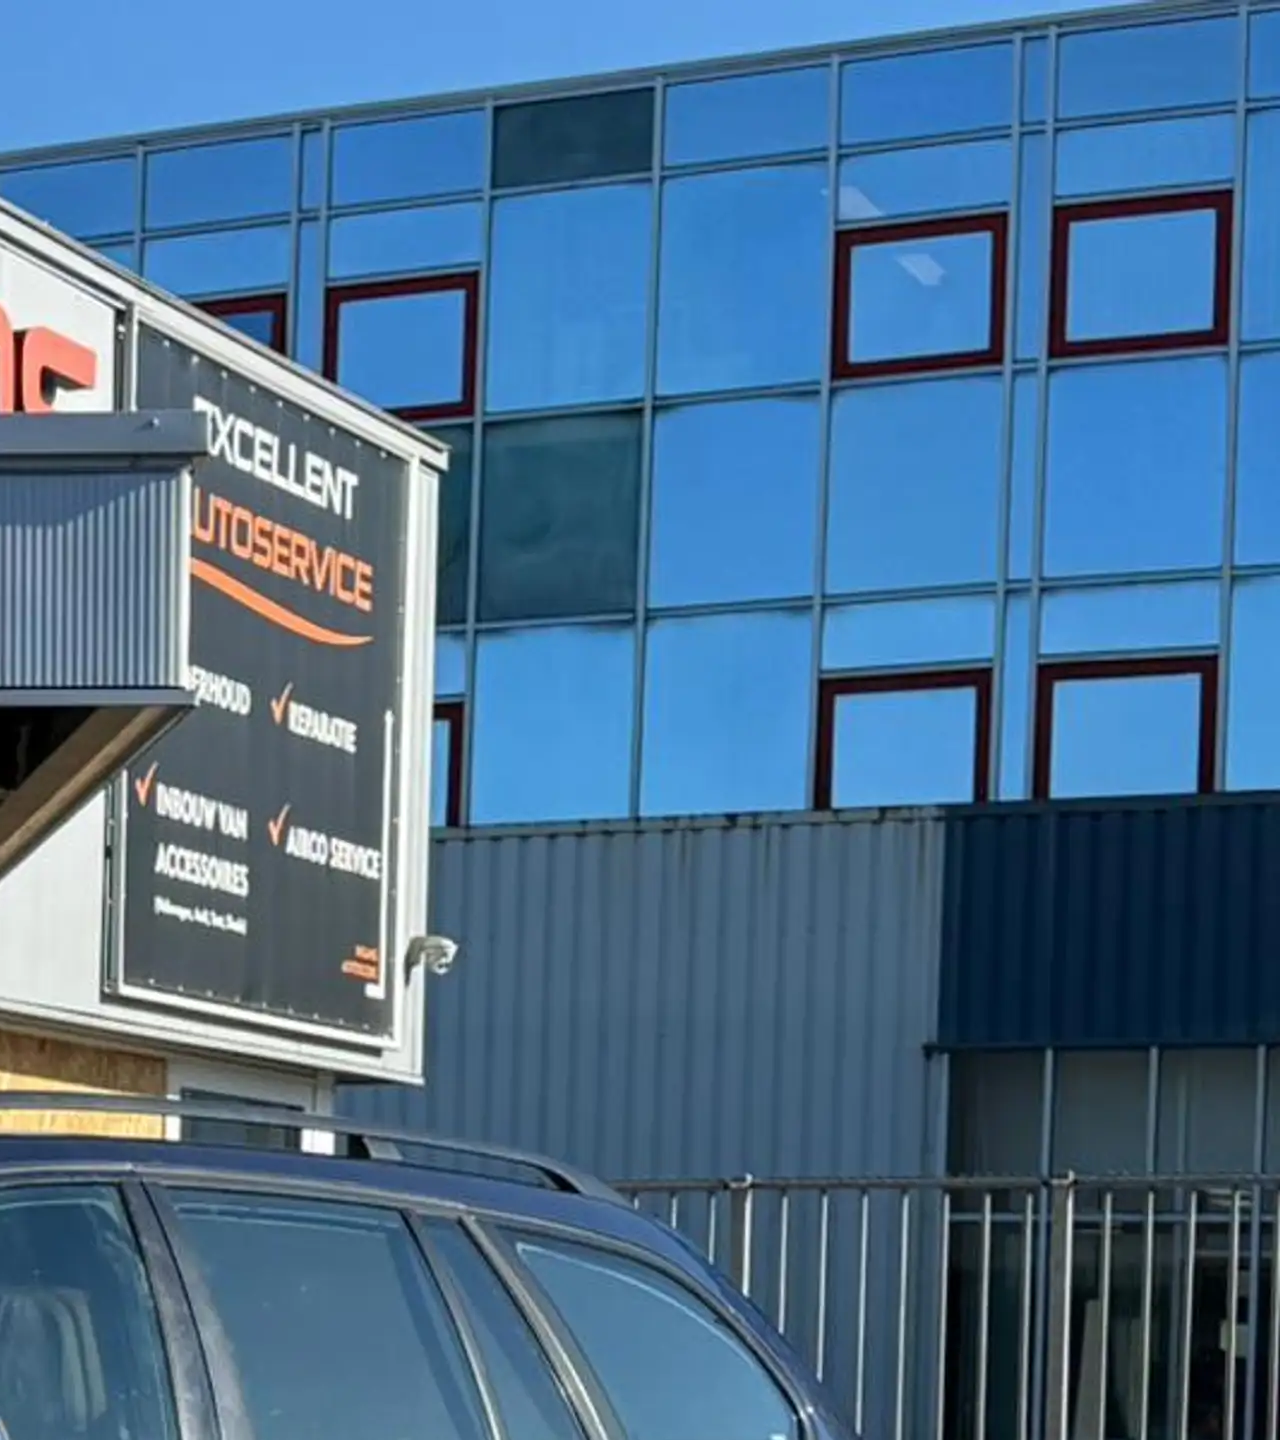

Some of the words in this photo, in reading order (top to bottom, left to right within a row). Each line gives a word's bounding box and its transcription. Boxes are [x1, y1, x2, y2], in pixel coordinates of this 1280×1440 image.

[192, 486, 374, 612] UTOSERVICE
[154, 842, 249, 898] ACCESSOIRES
[330, 837, 381, 880] SERVICE
